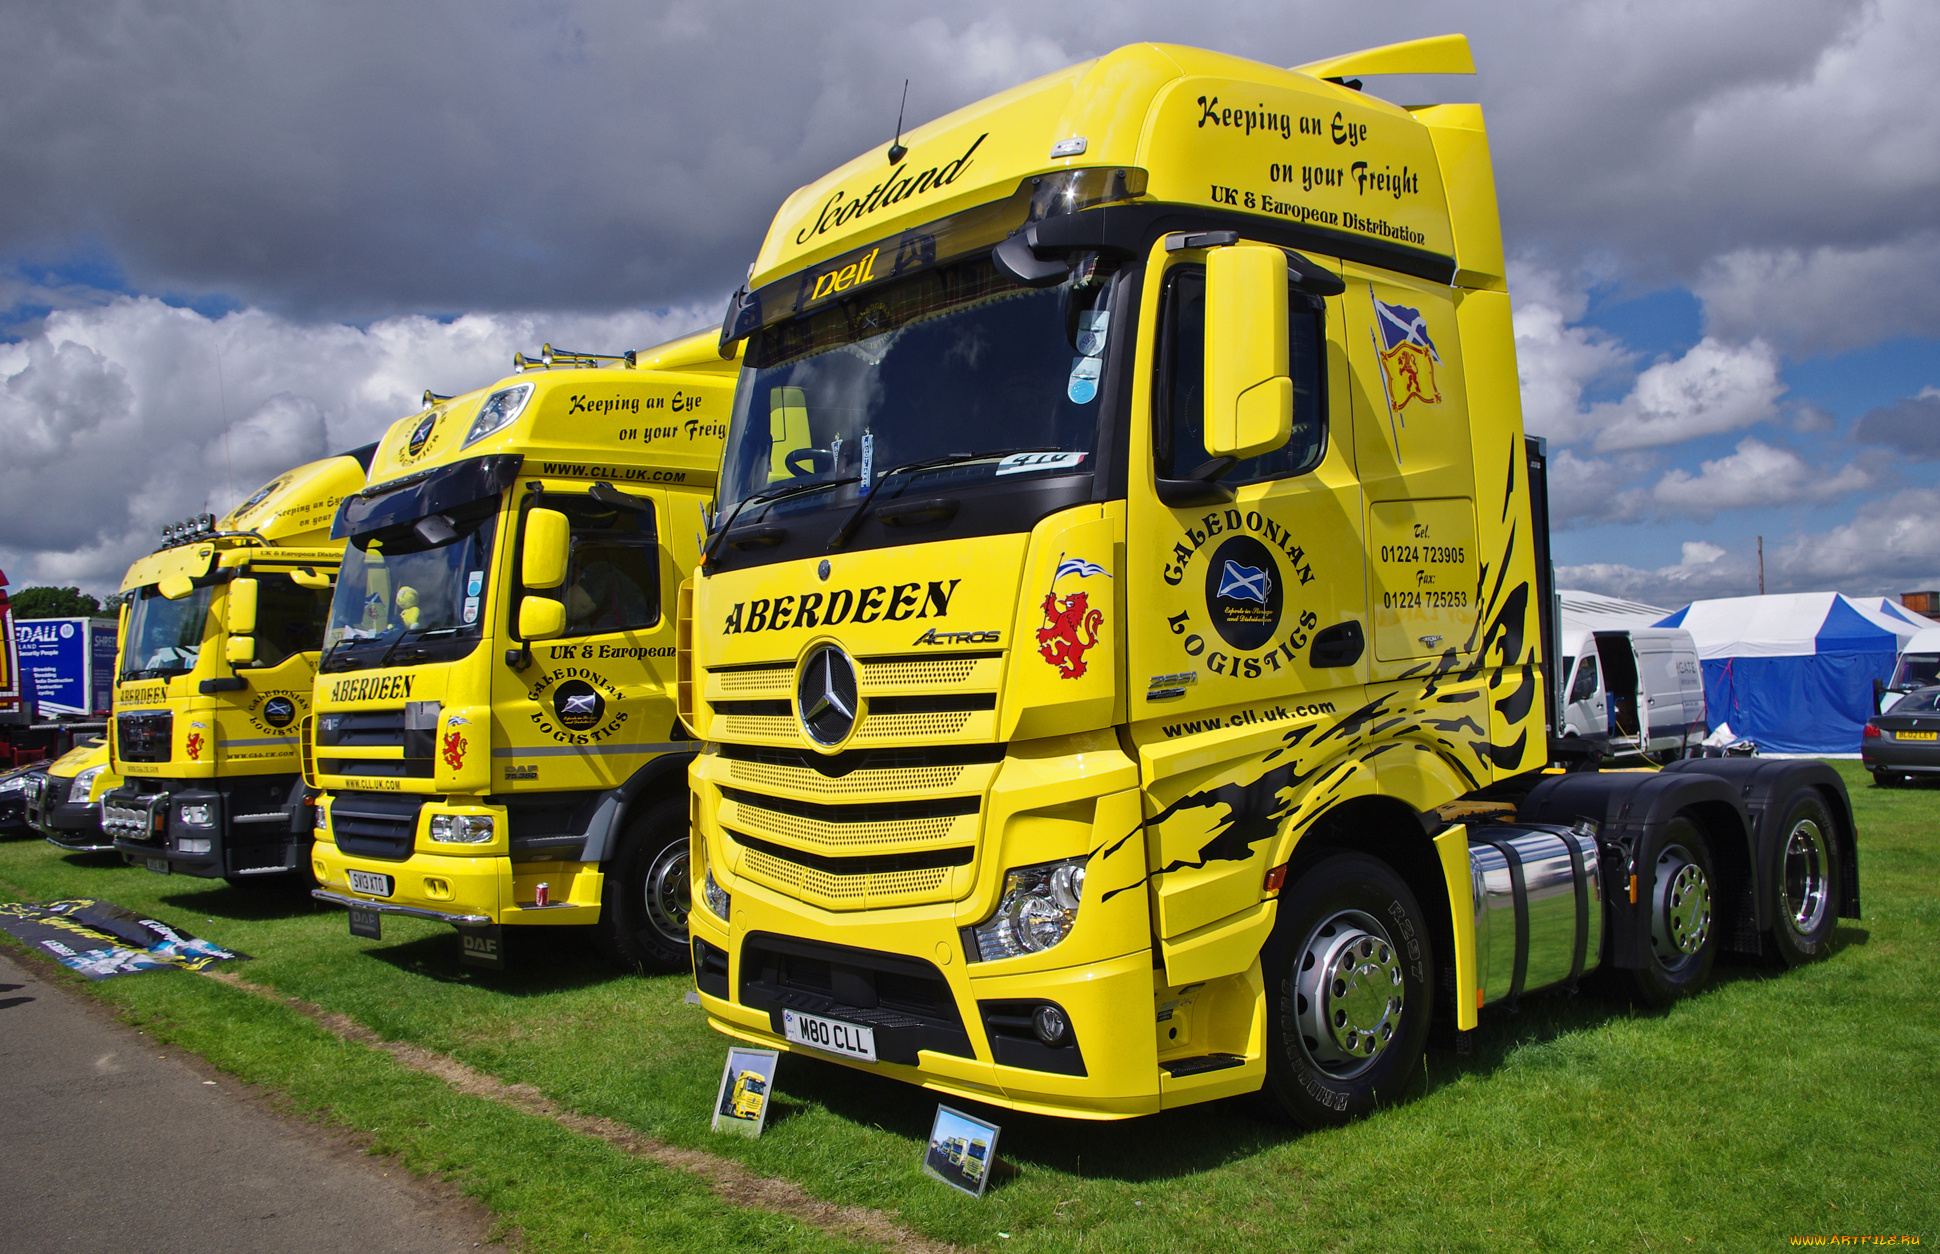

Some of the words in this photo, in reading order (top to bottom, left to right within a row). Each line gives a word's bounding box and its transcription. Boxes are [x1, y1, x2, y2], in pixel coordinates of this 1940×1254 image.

[1197, 96, 1291, 139] Keeping
[1300, 115, 1322, 135] an
[1331, 111, 1367, 147] Eye
[796, 132, 989, 245] Scotland
[1270, 163, 1293, 182] on
[1302, 165, 1344, 192] your
[1351, 161, 1419, 200] Freight
[1211, 185, 1238, 206] UK
[1244, 191, 1256, 209] &
[1261, 194, 1338, 226] European
[1342, 211, 1425, 245] Distribution
[568, 393, 640, 415] Keeping
[646, 396, 664, 409] an
[671, 391, 702, 412] Eye
[619, 427, 637, 441] on
[644, 426, 678, 443] your
[543, 462, 686, 483] WWW.CLL.UK.COM
[275, 504, 310, 517] Keeping
[313, 501, 324, 509] an
[299, 518, 310, 526] on
[312, 514, 331, 525] your
[1414, 524, 1430, 538] Tel.
[1164, 509, 1315, 586] CALEDONIAN
[1382, 545, 1419, 562] 01224
[1423, 547, 1465, 563] 723905
[1416, 570, 1436, 587] Fax:
[722, 579, 961, 635] ABERDEEN
[1384, 592, 1422, 609] 01224
[1426, 592, 1467, 608] 725253
[912, 628, 1001, 646] ACTROS
[1168, 610, 1317, 679] LOGISTICS
[550, 645, 577, 660] UK
[581, 645, 593, 659] &
[598, 644, 676, 660] European
[331, 674, 416, 702] ABERDEEN
[527, 667, 627, 702] CALEDONIAN
[1148, 671, 1197, 688] 2551
[120, 686, 169, 706] ABERDEEN
[248, 689, 309, 711] CALEDONIAN
[530, 711, 628, 745] LOGISTICS
[1162, 702, 1337, 738] www.cll.uk.com
[345, 779, 402, 790] WWW.CLL.UK.COM
[353, 912, 376, 925] DAF
[463, 935, 497, 952] DAF
[799, 1016, 830, 1045] M80
[833, 1025, 869, 1054] CLL
